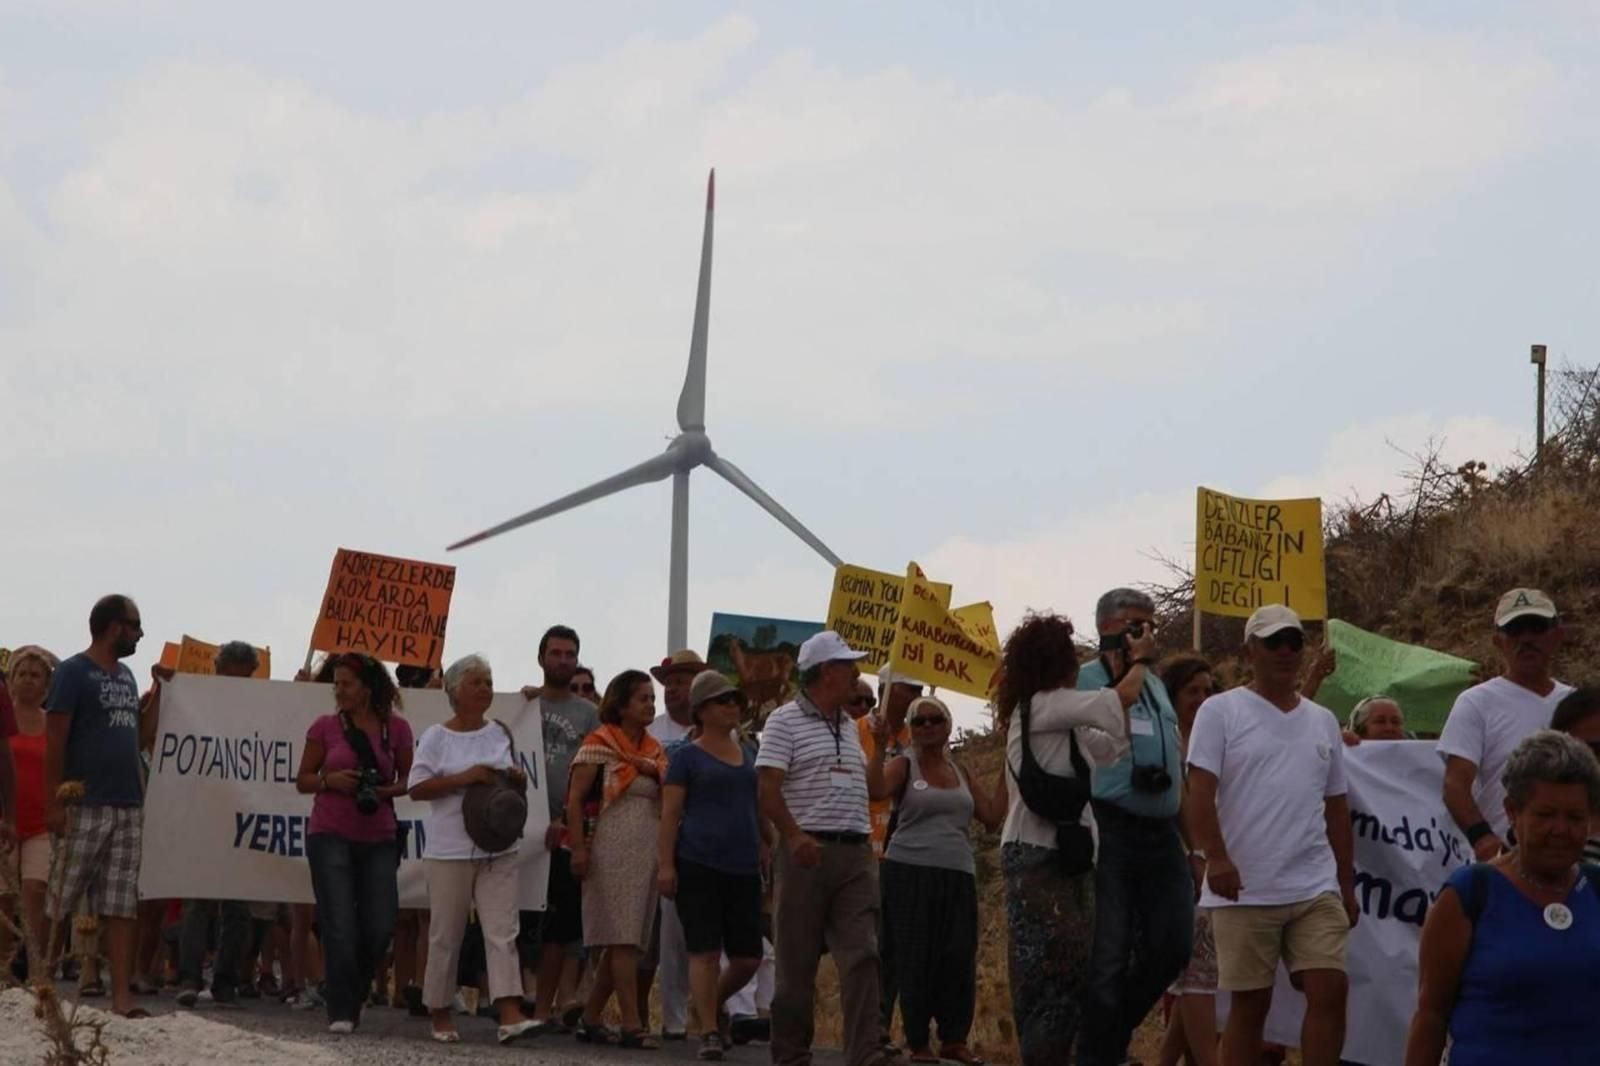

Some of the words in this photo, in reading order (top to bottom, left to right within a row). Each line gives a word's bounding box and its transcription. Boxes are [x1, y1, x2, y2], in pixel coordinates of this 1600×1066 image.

[1511, 592, 1534, 608] A
[335, 626, 419, 658] HAYIR
[933, 653, 973, 684] BAK
[158, 731, 298, 783] POTANSİYEL
